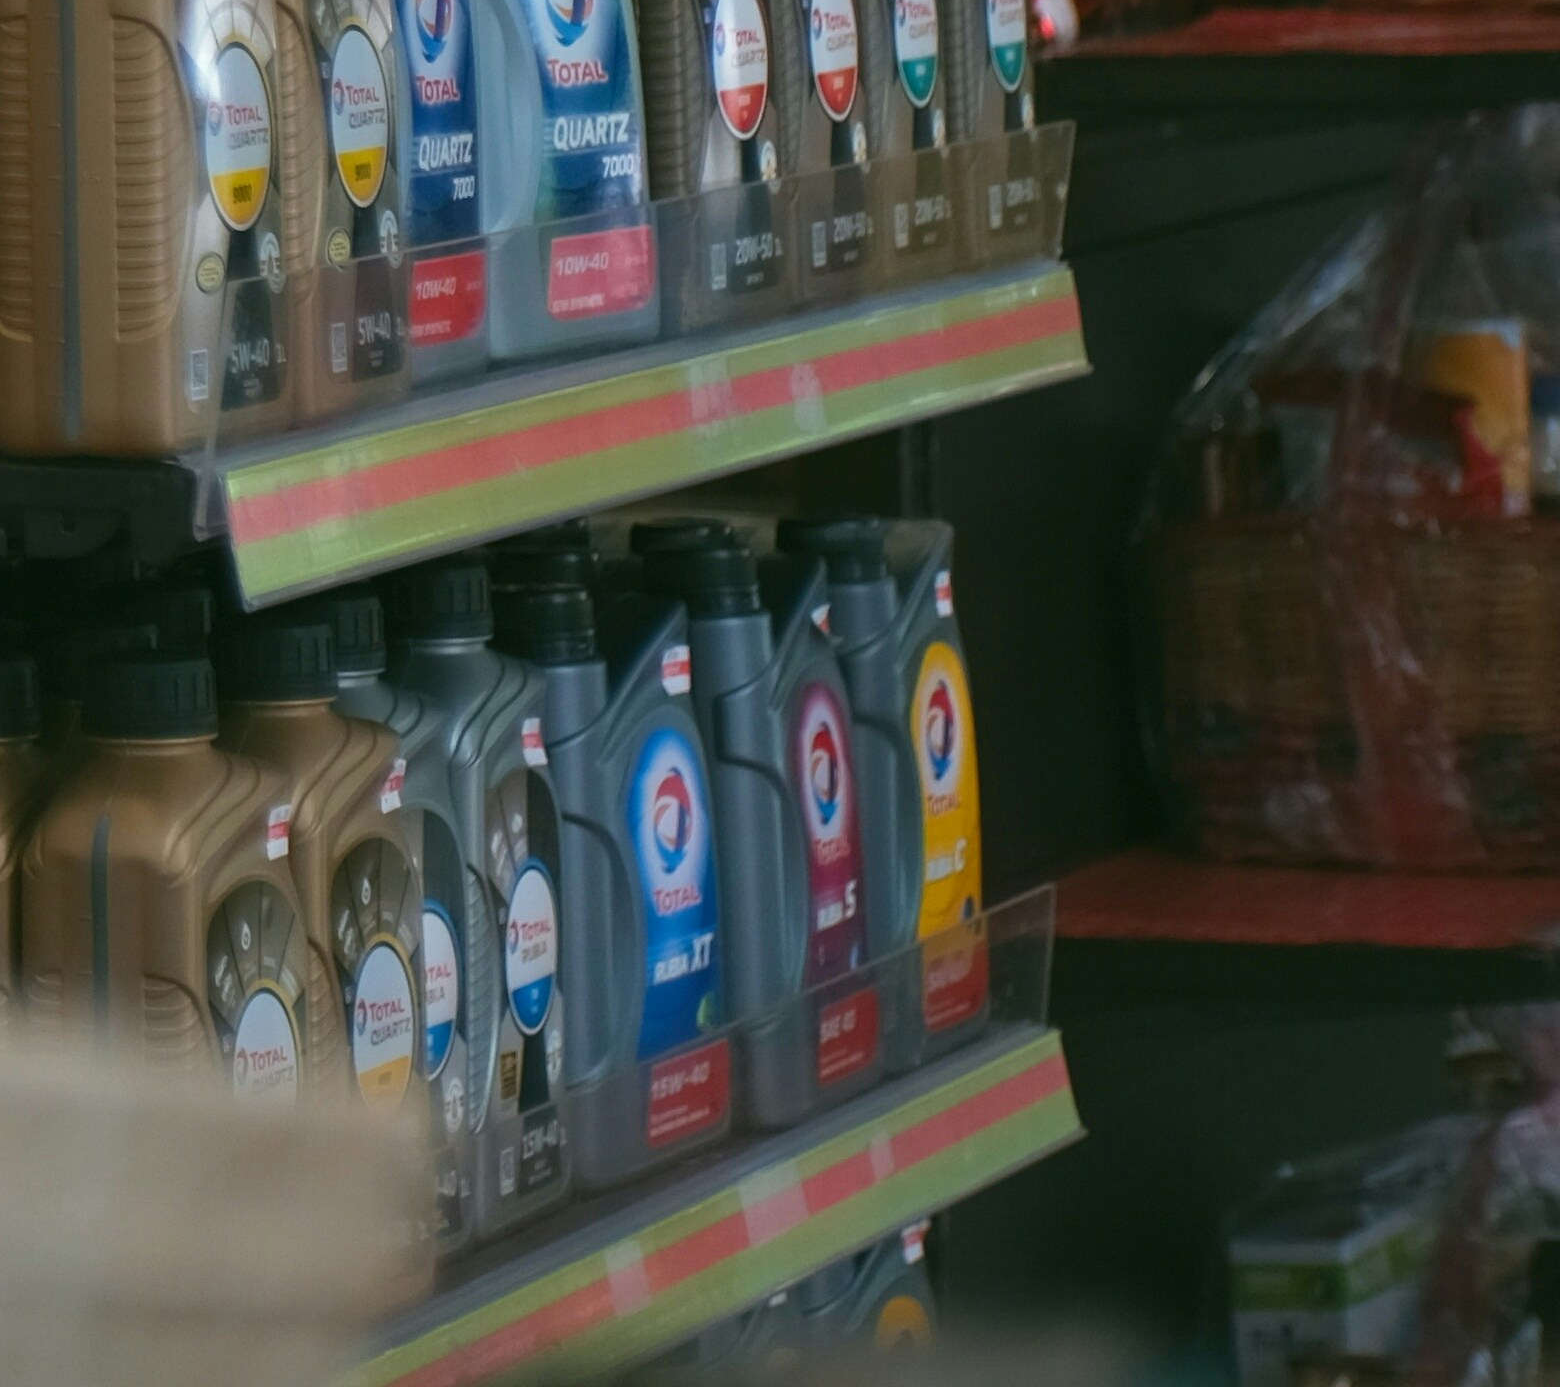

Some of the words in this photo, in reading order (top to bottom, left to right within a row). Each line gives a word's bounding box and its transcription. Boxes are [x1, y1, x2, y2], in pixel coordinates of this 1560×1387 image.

[823, 11, 852, 31] TOTAL
[547, 59, 609, 88] TOTAL
[344, 84, 380, 106] TOTAL
[416, 76, 461, 104] TOTAL
[225, 104, 263, 126] TOTAL
[348, 107, 386, 129] QUARTZ
[227, 127, 269, 151] QUARTZ
[553, 112, 630, 152] QUARTZ
[418, 133, 474, 172] QUARTZ
[601, 154, 636, 180] 7000
[555, 251, 609, 277] 10W-40
[928, 793, 961, 818] TOTAL
[654, 884, 703, 918] TOTAL
[519, 920, 552, 941] TOTAL
[691, 932, 714, 973] XT
[368, 998, 406, 1023] TOTAL
[371, 1018, 412, 1047] QUARTZ
[248, 1046, 288, 1072] TOTAL
